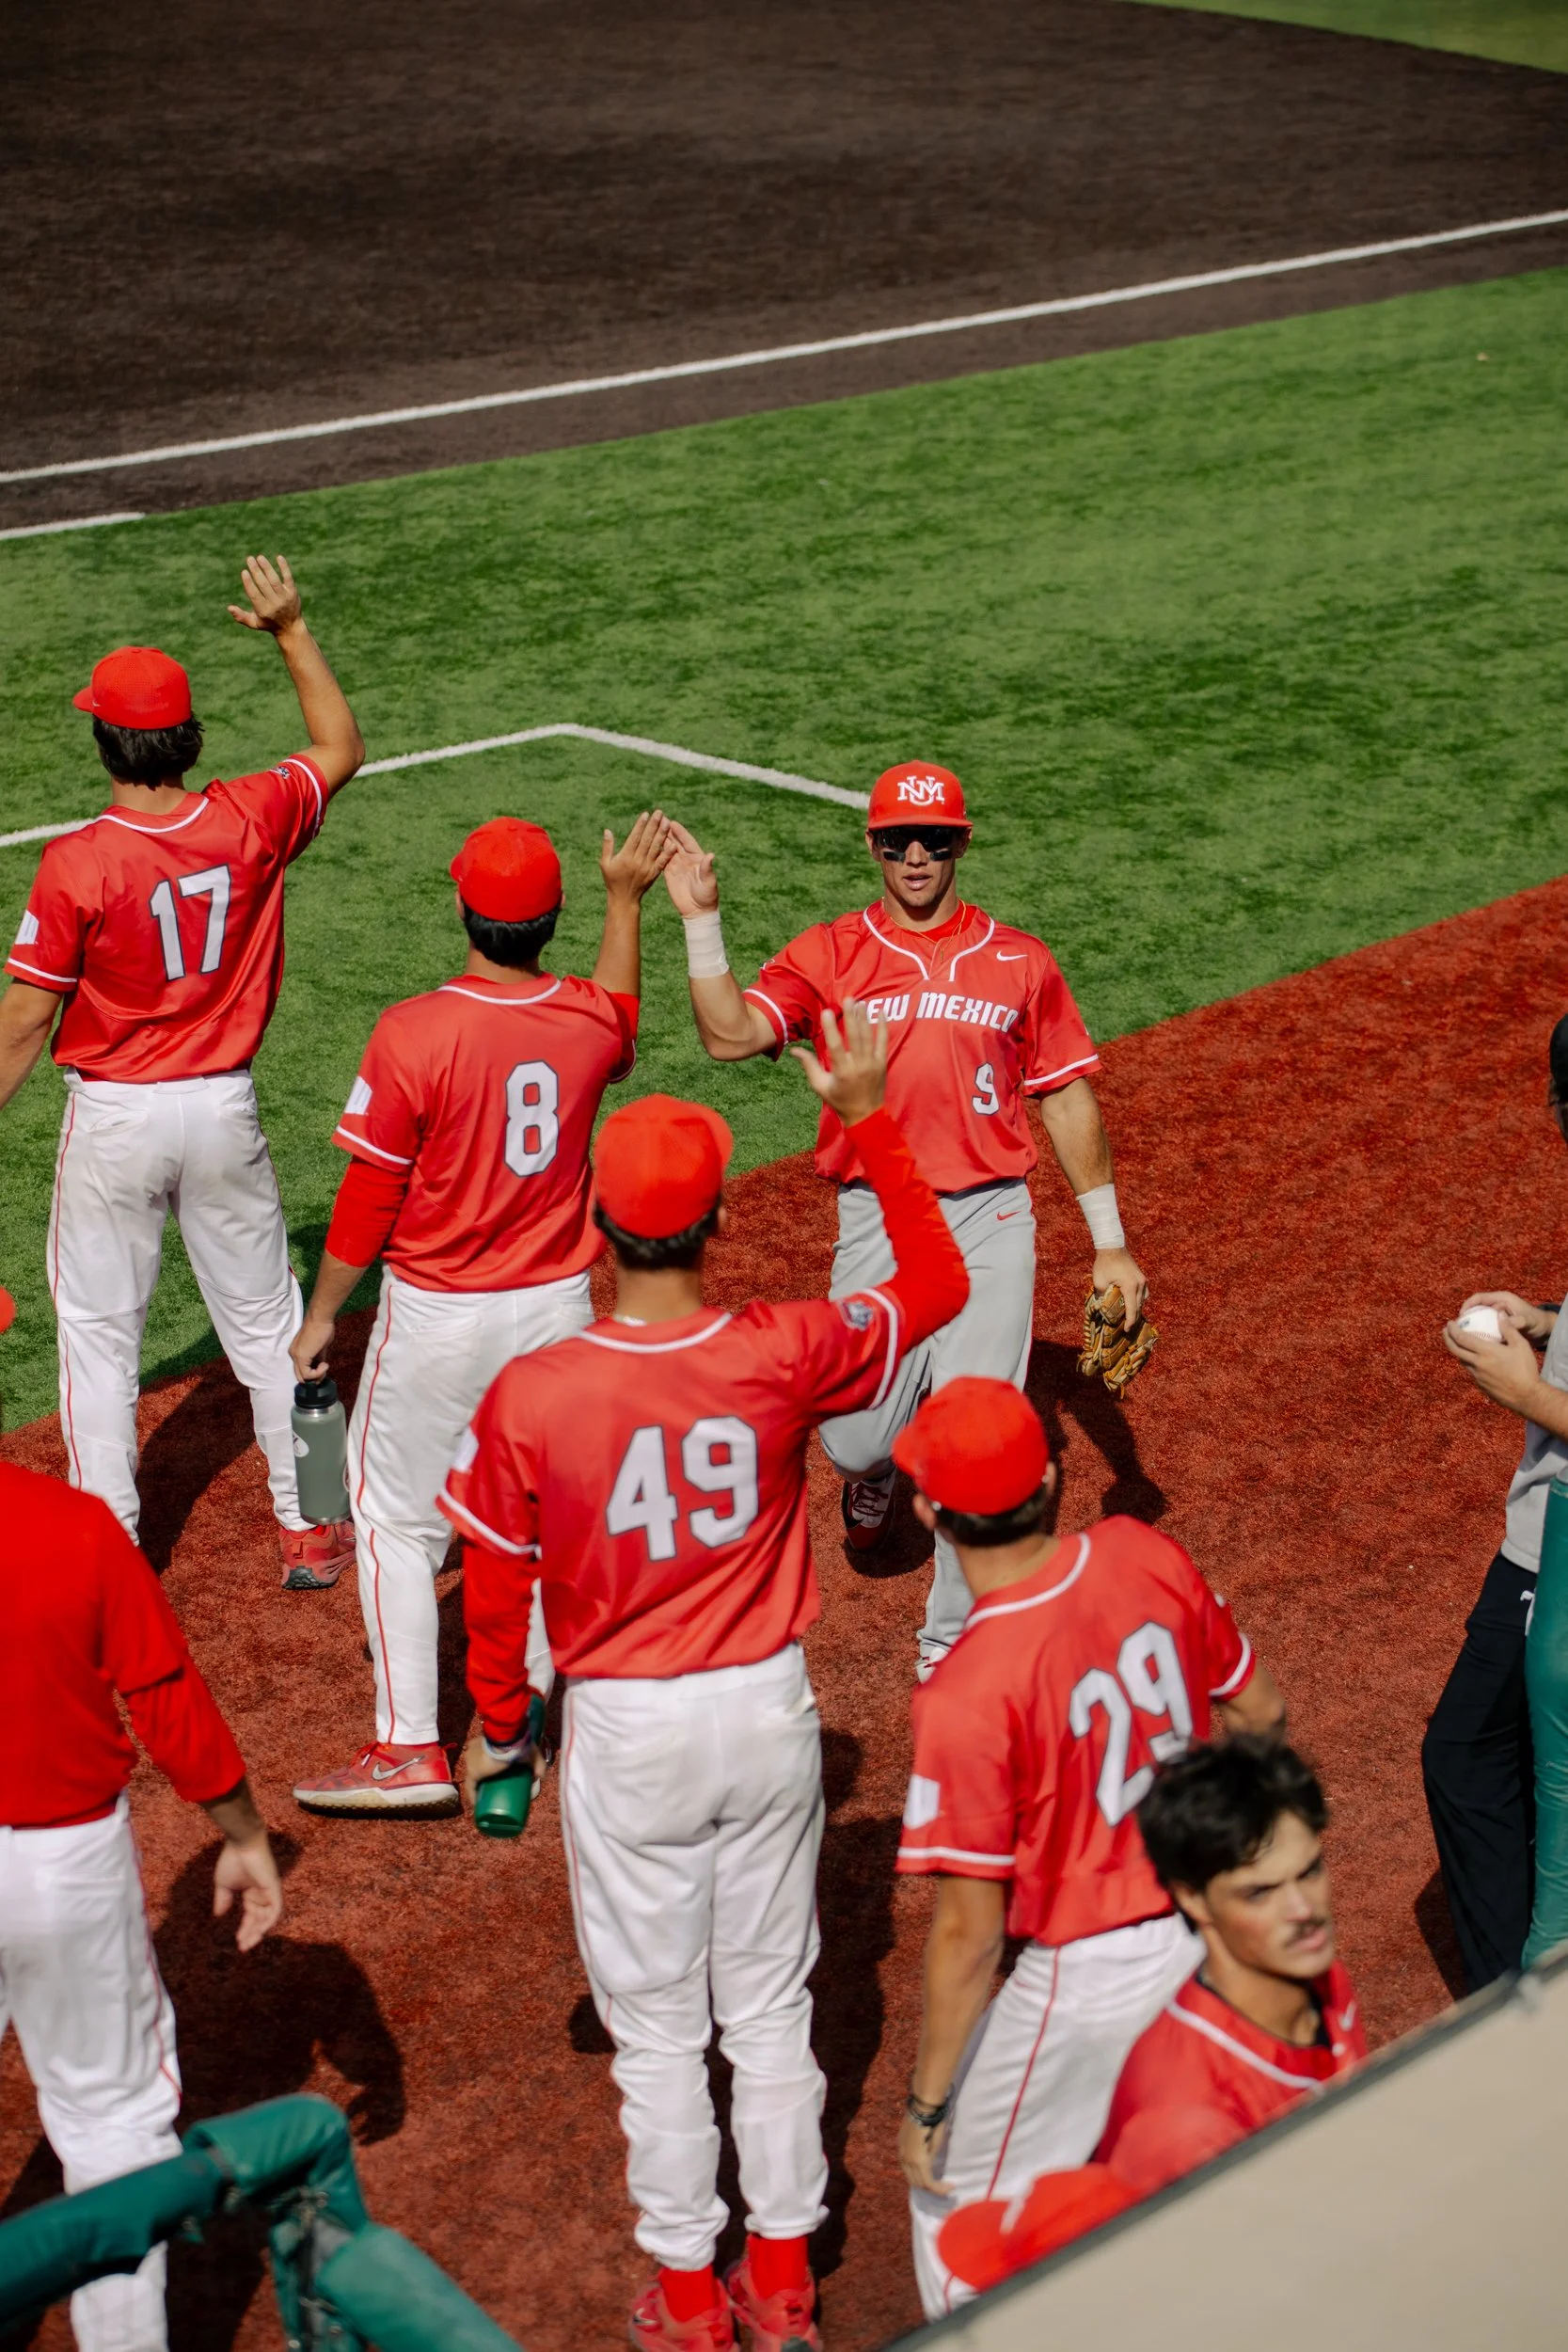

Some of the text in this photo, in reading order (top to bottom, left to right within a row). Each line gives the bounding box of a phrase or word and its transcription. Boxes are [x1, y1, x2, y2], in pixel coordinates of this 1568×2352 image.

[149, 864, 232, 981] 17
[857, 993, 911, 1025] EW
[503, 1059, 560, 1178] 8
[607, 1415, 758, 1561] 49
[1069, 1619, 1193, 1828] 29
